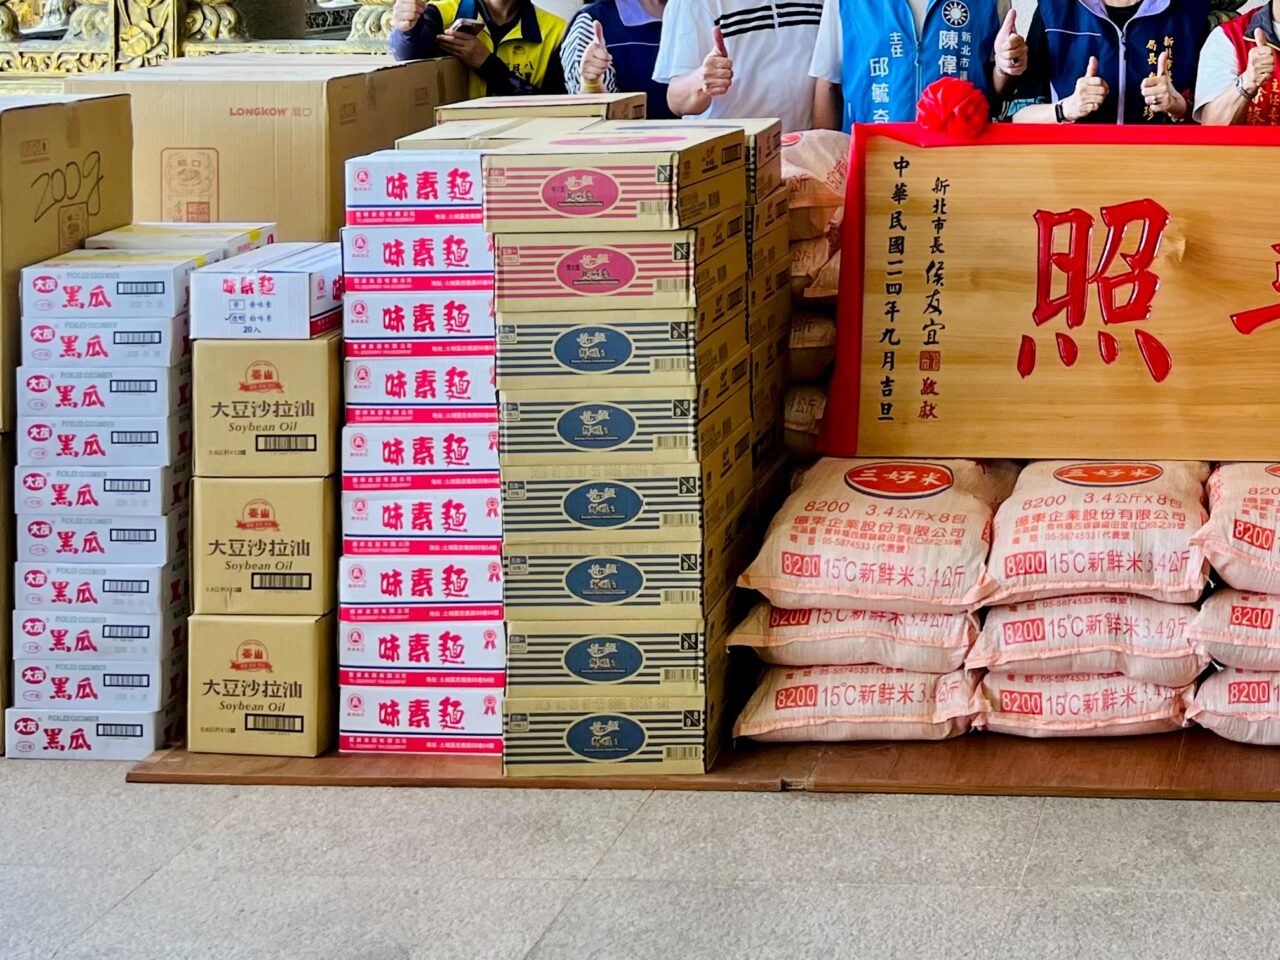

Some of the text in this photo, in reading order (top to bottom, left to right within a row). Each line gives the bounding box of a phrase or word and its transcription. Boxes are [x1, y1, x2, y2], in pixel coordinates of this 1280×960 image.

[889, 32, 904, 58] 主任
[229, 106, 288, 117] LONGKOW
[386, 167, 474, 202] 味素麵
[383, 234, 470, 269] 味素麵
[921, 176, 950, 346] 新北市長侯友宜
[61, 285, 112, 308] 黑瓜
[877, 155, 911, 421] 中華民國一一四年九月吉旦
[382, 300, 471, 334] 味素麵
[59, 335, 109, 358] 黑瓜
[385, 366, 472, 401] 味素麵
[55, 385, 106, 408] 黑瓜
[210, 400, 315, 419] 大豆沙拉油
[228, 421, 298, 434] Soybean Oil
[56, 434, 106, 457] 黑瓜
[381, 433, 470, 467] 味素麵
[853, 468, 946, 486] 三好米
[1064, 467, 1151, 479] 三好米
[50, 483, 100, 507] 黑瓜
[804, 500, 850, 513] 8200
[1022, 494, 1067, 510] 8200
[381, 498, 468, 533] 味素麵
[56, 531, 106, 555] 黑瓜
[1235, 521, 1274, 549] 8200
[208, 539, 310, 557] 大豆沙拉油
[225, 561, 293, 572] Soybean Oil
[783, 554, 820, 576] 8200
[1006, 553, 1045, 576] 8200
[51, 581, 98, 605] 黑瓜
[380, 564, 469, 599] 味素麵
[1231, 607, 1272, 629] 8200
[49, 629, 98, 653] 黑瓜
[1004, 619, 1044, 644] 8200
[378, 630, 466, 665] 味素麵
[49, 677, 99, 701] 黑瓜
[202, 679, 303, 699] 大豆沙拉油
[777, 687, 817, 708] 8200
[1229, 682, 1270, 703] 8200
[219, 701, 286, 713] Soybean Oil
[378, 696, 465, 731] 味素麵
[1002, 693, 1041, 713] 8200
[43, 728, 92, 752] 黑瓜
